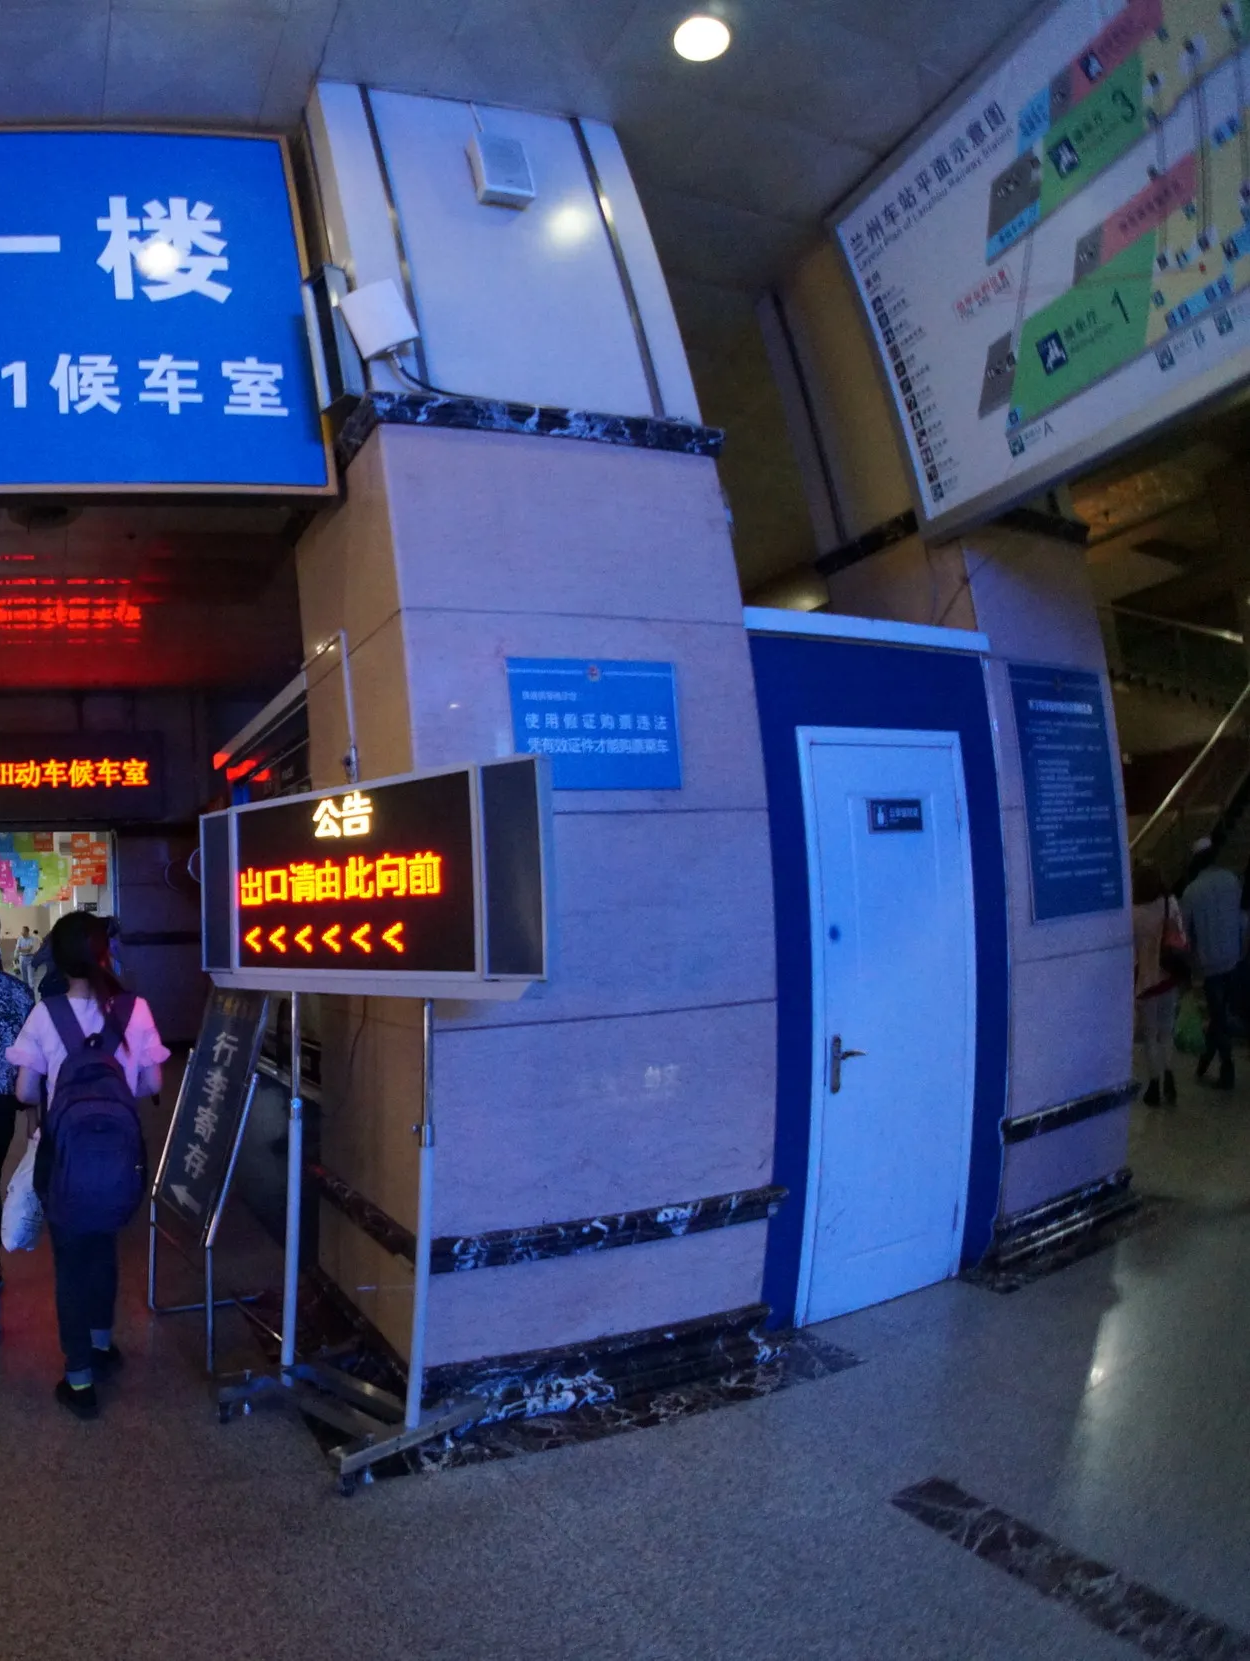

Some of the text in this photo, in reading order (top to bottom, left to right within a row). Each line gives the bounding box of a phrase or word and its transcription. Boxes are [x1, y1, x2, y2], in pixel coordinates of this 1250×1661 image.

[850, 101, 1007, 261] 兰州车站平面示意图
[312, 789, 374, 839] 公告
[239, 850, 443, 906] 出口请由此向前
[183, 1030, 240, 1180] 行李寄存
